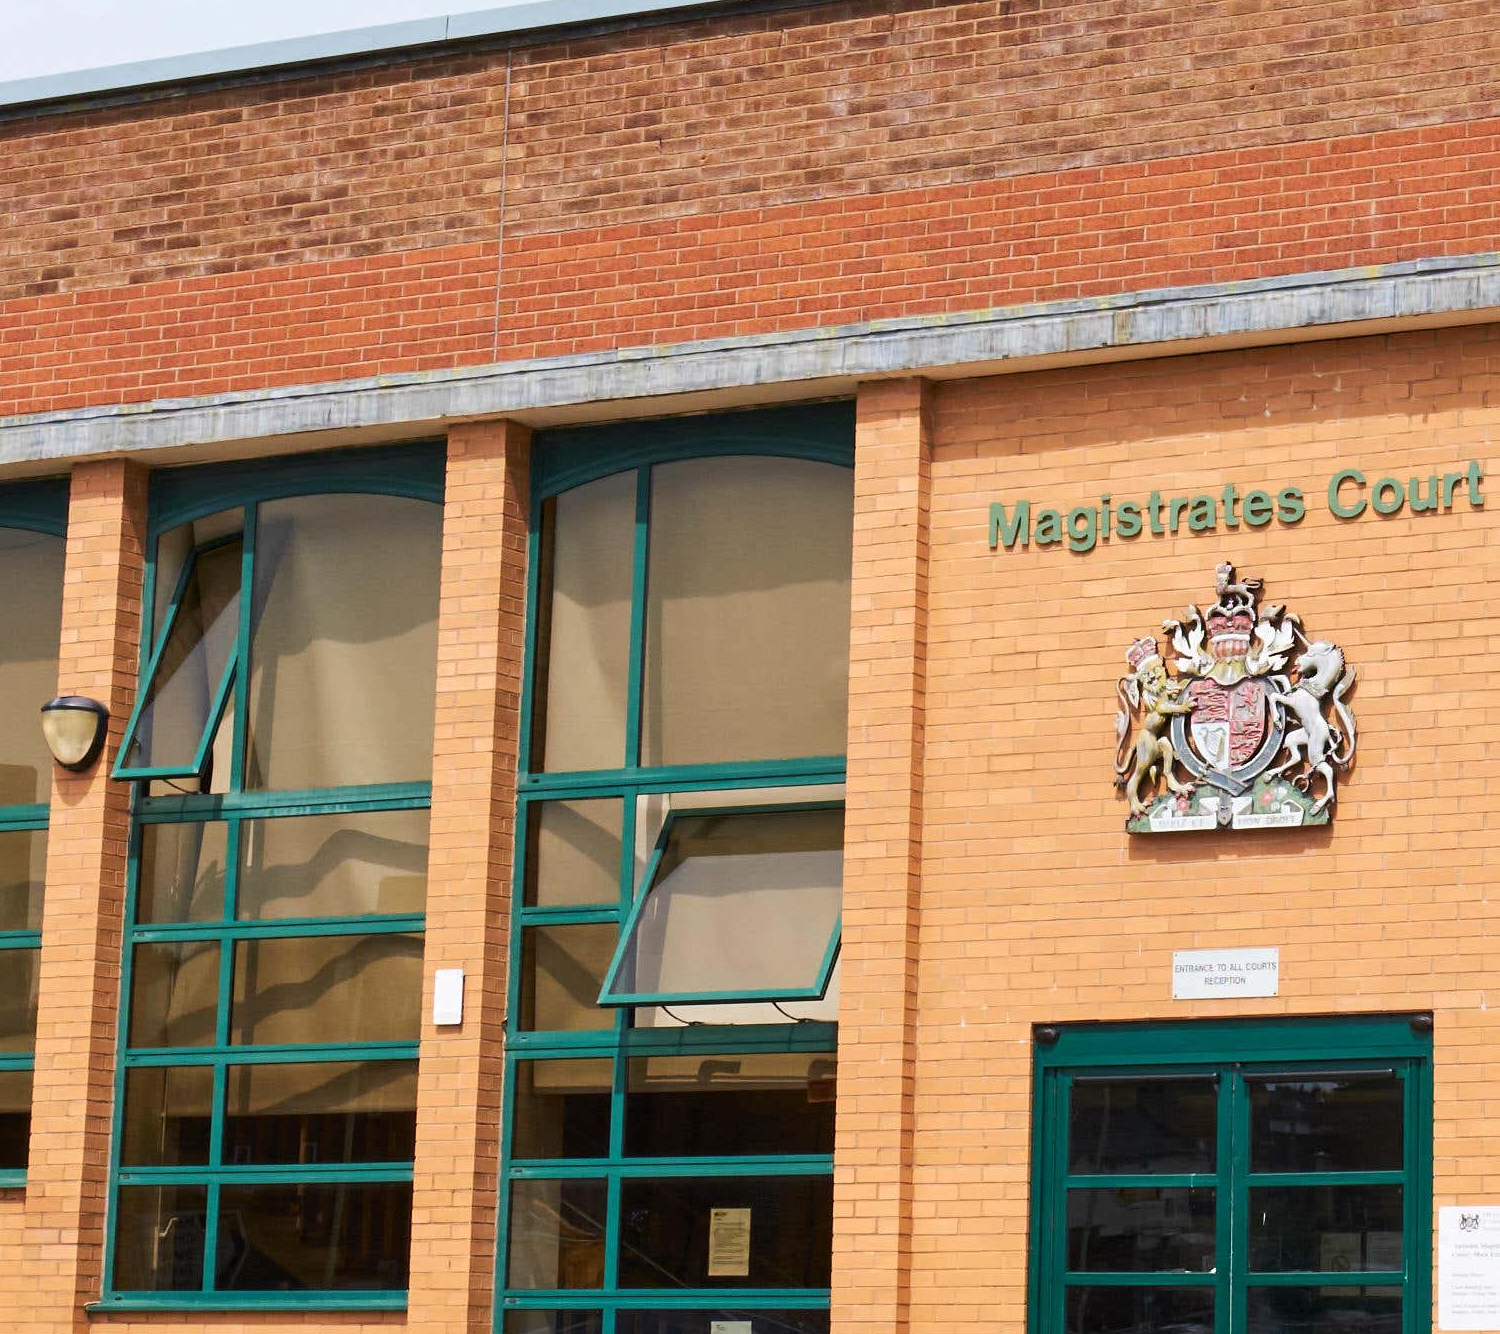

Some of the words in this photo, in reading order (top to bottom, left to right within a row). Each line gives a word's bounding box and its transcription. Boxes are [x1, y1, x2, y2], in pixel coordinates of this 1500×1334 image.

[988, 483, 1305, 553] Magistrates
[1327, 460, 1486, 519] Court
[1174, 964, 1214, 973] ENTRANCE
[1217, 964, 1227, 972] TO
[1229, 962, 1244, 972] ALL
[1245, 962, 1277, 971] COURTS
[1204, 976, 1246, 985] RECEPTION
